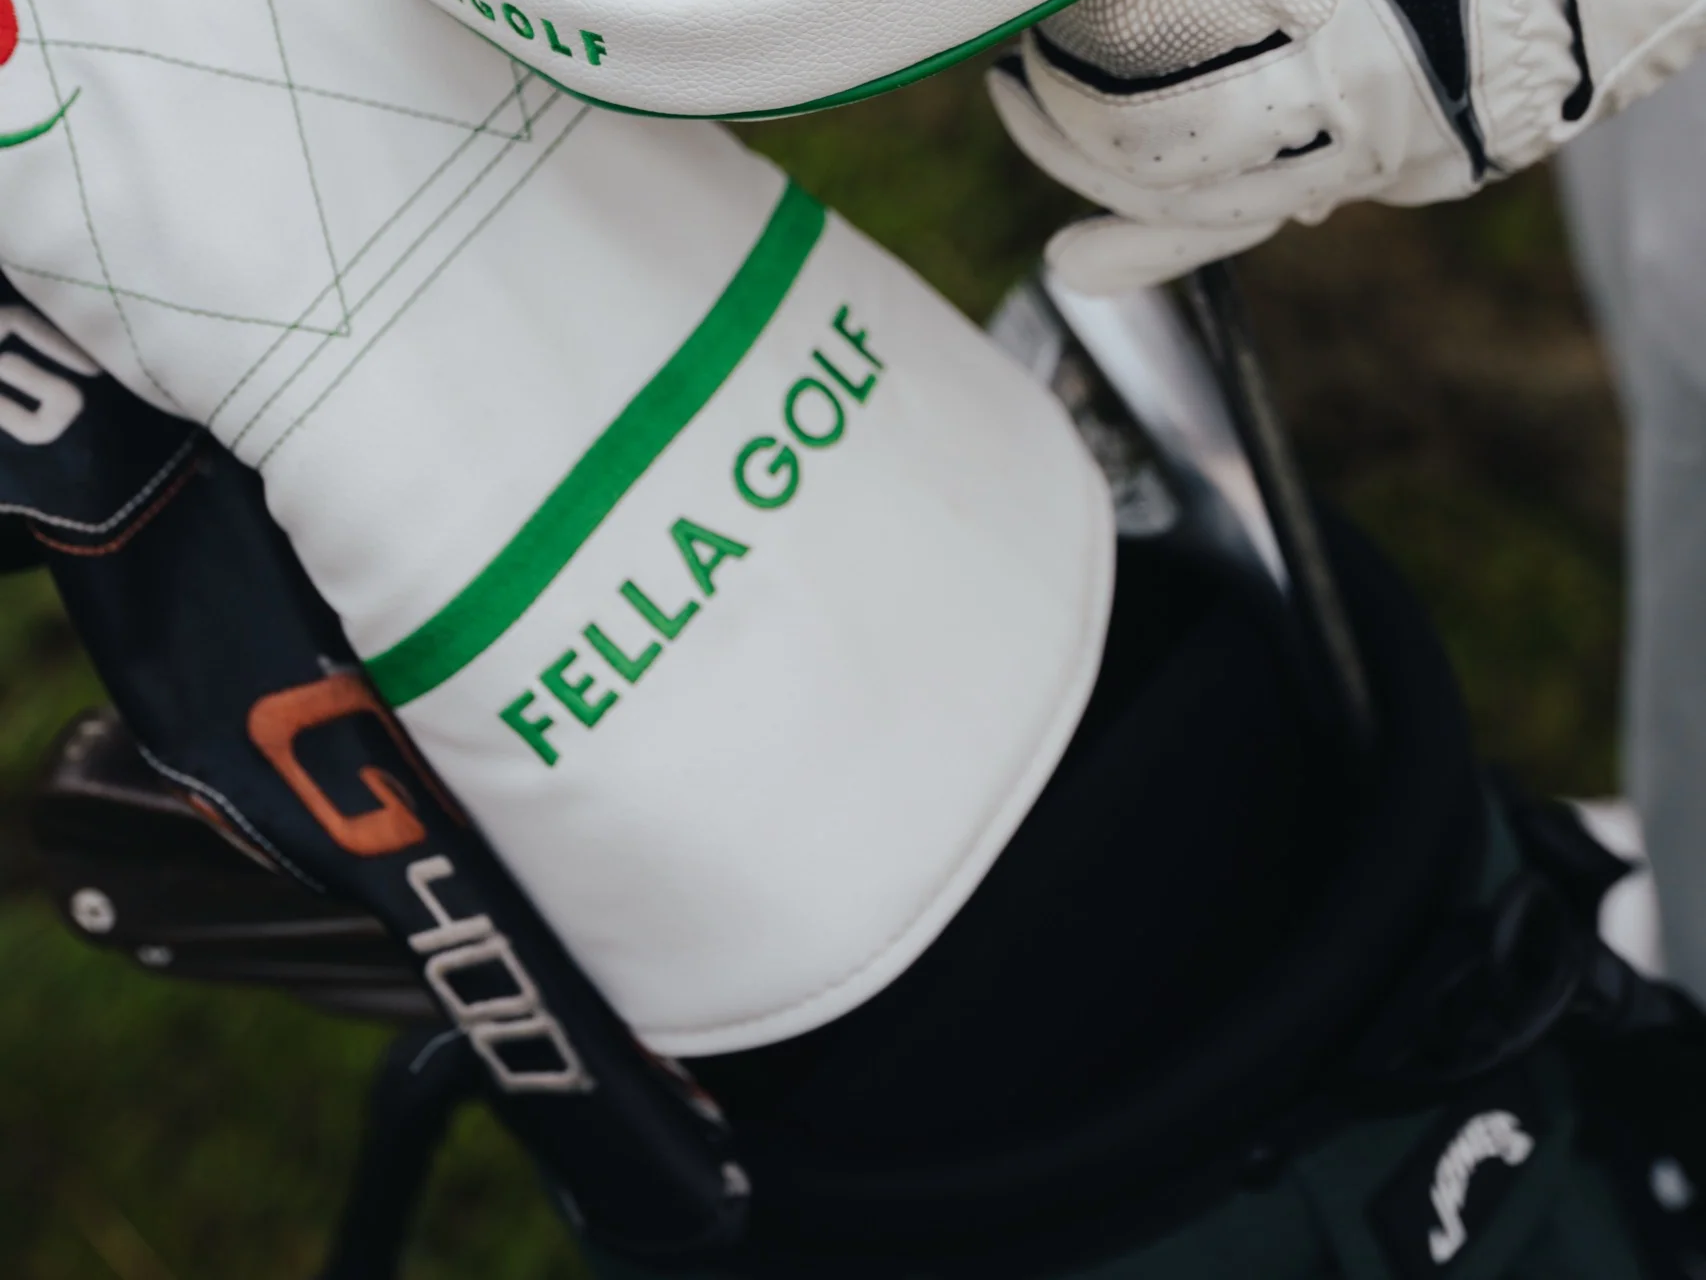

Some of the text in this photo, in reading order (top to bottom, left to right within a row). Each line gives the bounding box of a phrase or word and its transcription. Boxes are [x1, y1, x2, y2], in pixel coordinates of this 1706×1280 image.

[499, 304, 885, 767] FELLA GOLF
[248, 674, 586, 1091] G400
